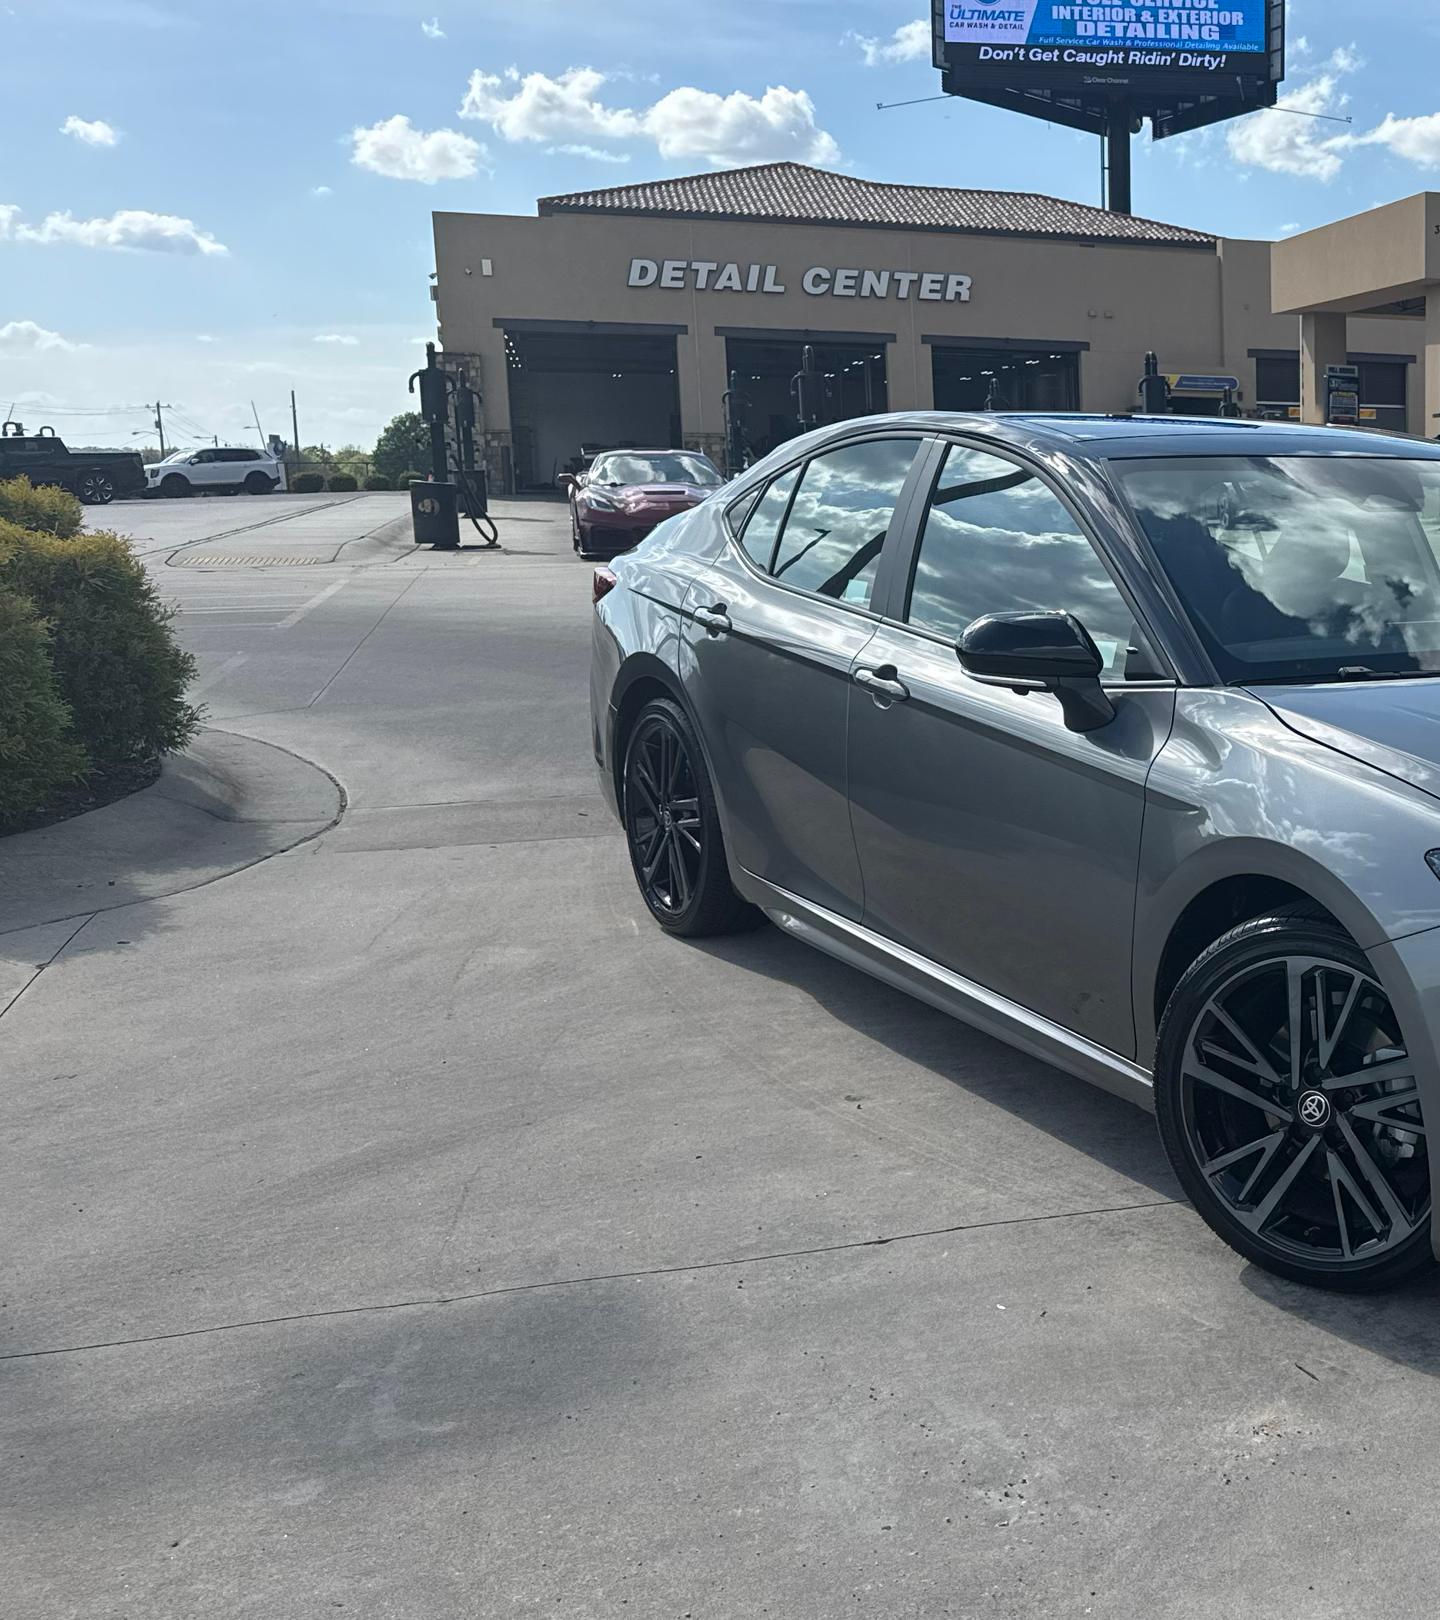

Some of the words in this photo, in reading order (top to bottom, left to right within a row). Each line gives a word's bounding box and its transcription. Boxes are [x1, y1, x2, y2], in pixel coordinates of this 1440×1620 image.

[949, 9, 1025, 21] ULTIMATE
[1051, 5, 1136, 21] INTERIOR
[1141, 10, 1154, 22] &
[1158, 9, 1244, 26] EXTERIOR
[949, 21, 965, 29] CAR
[998, 23, 1024, 31] DETAIL
[1076, 21, 1220, 40] DETAILING
[1039, 36, 1054, 44] Full
[1056, 37, 1082, 45] Service
[1134, 40, 1183, 49] Professional
[1184, 41, 1220, 51] Detailing
[1222, 42, 1259, 51] Available
[979, 46, 1025, 61] Don't
[1029, 48, 1060, 61] Get
[1063, 49, 1125, 66] Caught
[1128, 51, 1176, 66] Ridin'
[1179, 53, 1227, 70] Dirty!
[626, 258, 786, 294] DETAIL
[801, 266, 974, 302] CENTER
